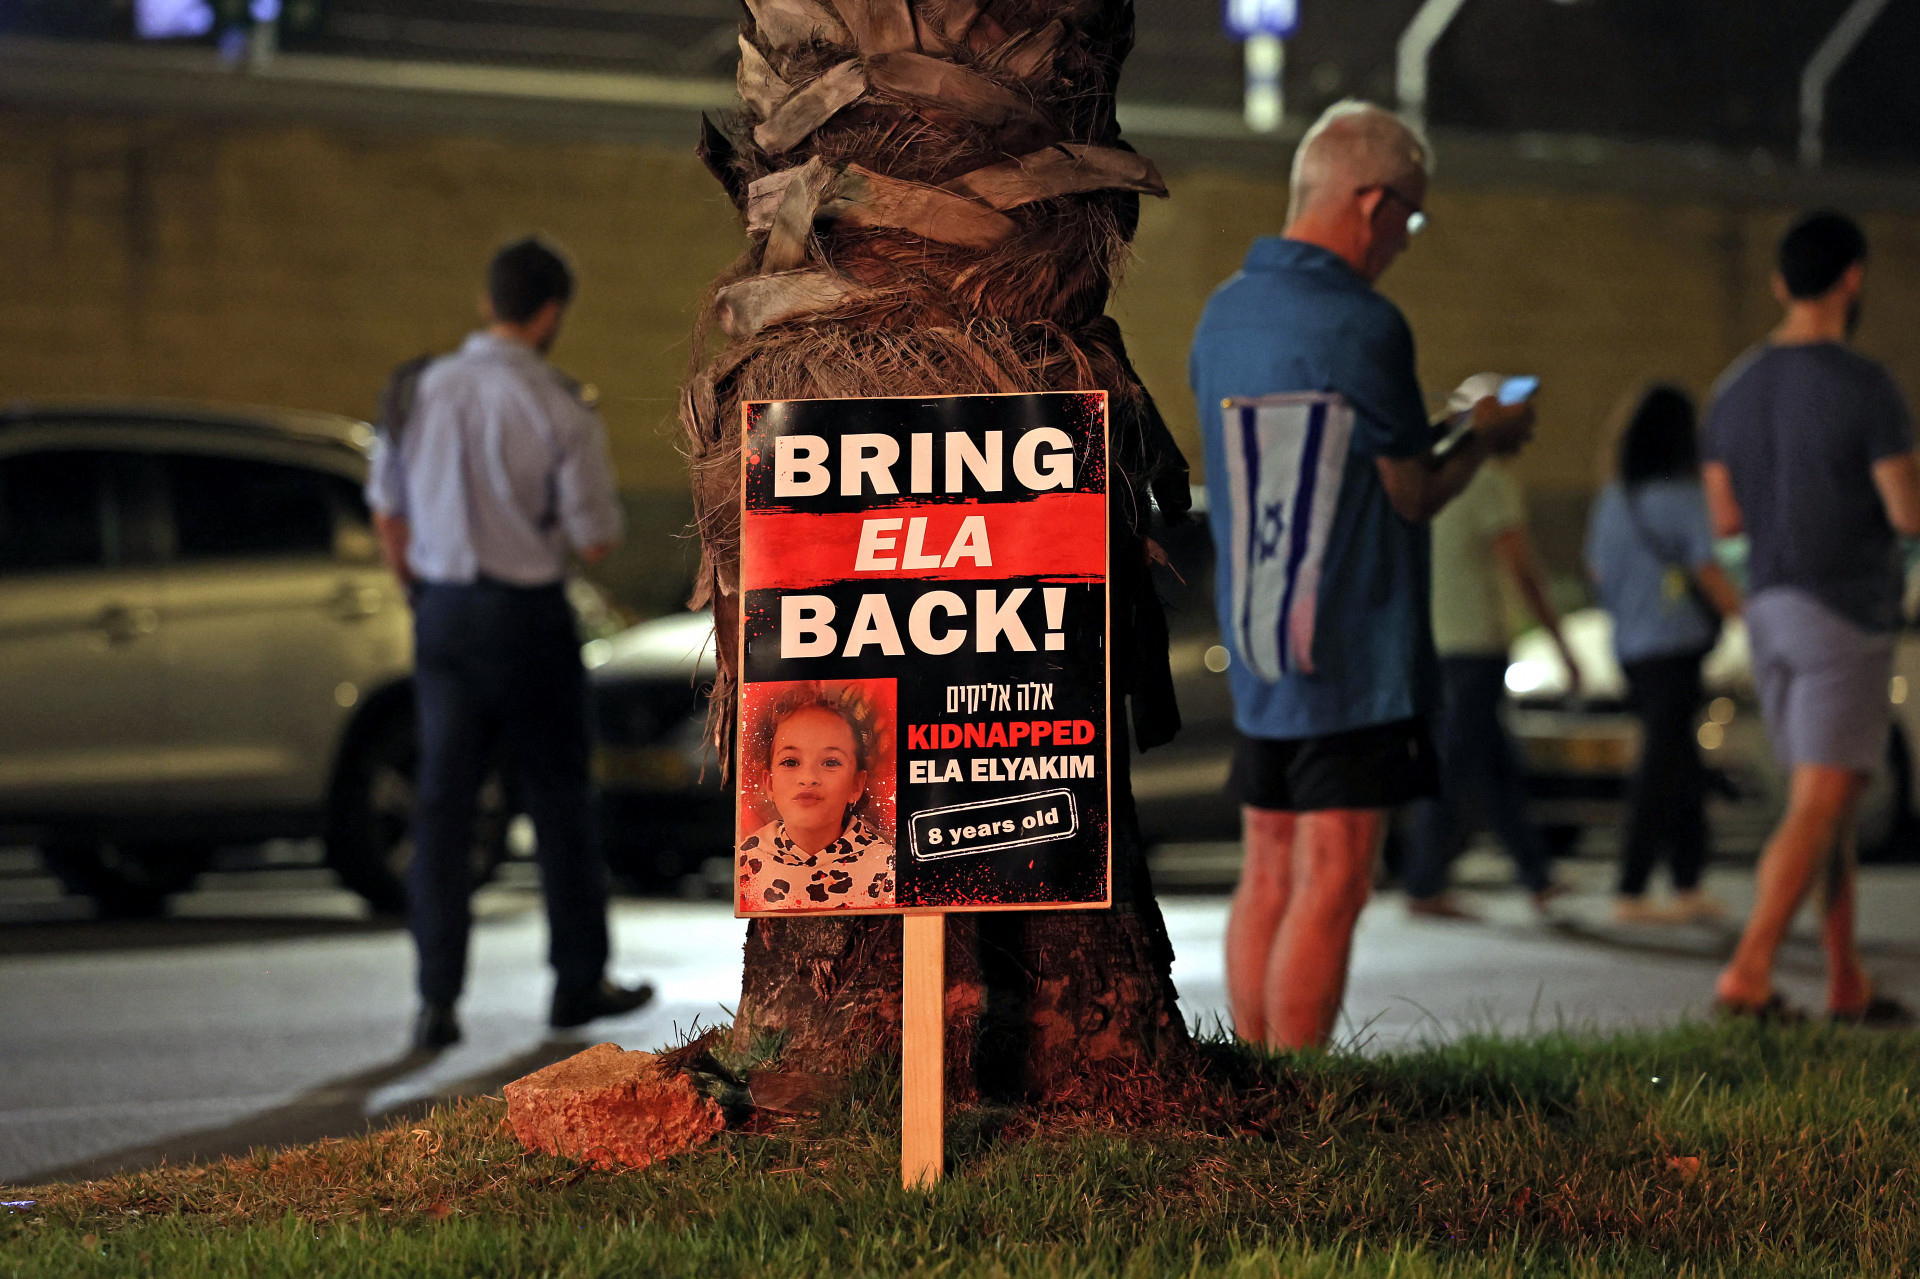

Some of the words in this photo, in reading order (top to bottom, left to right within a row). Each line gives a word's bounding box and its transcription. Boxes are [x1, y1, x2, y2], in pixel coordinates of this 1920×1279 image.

[774, 426, 1075, 497] BRING
[854, 515, 993, 572] ELA
[780, 587, 1067, 659] BACK!
[946, 682, 1012, 715] אליקים
[1016, 682, 1055, 711] אלה
[908, 719, 1096, 750] KIDNAPPED
[909, 759, 964, 784] ELA
[971, 755, 1095, 782] ELYAKIM
[928, 828, 943, 845] 8
[949, 817, 1016, 846] years
[1022, 807, 1059, 829] old
